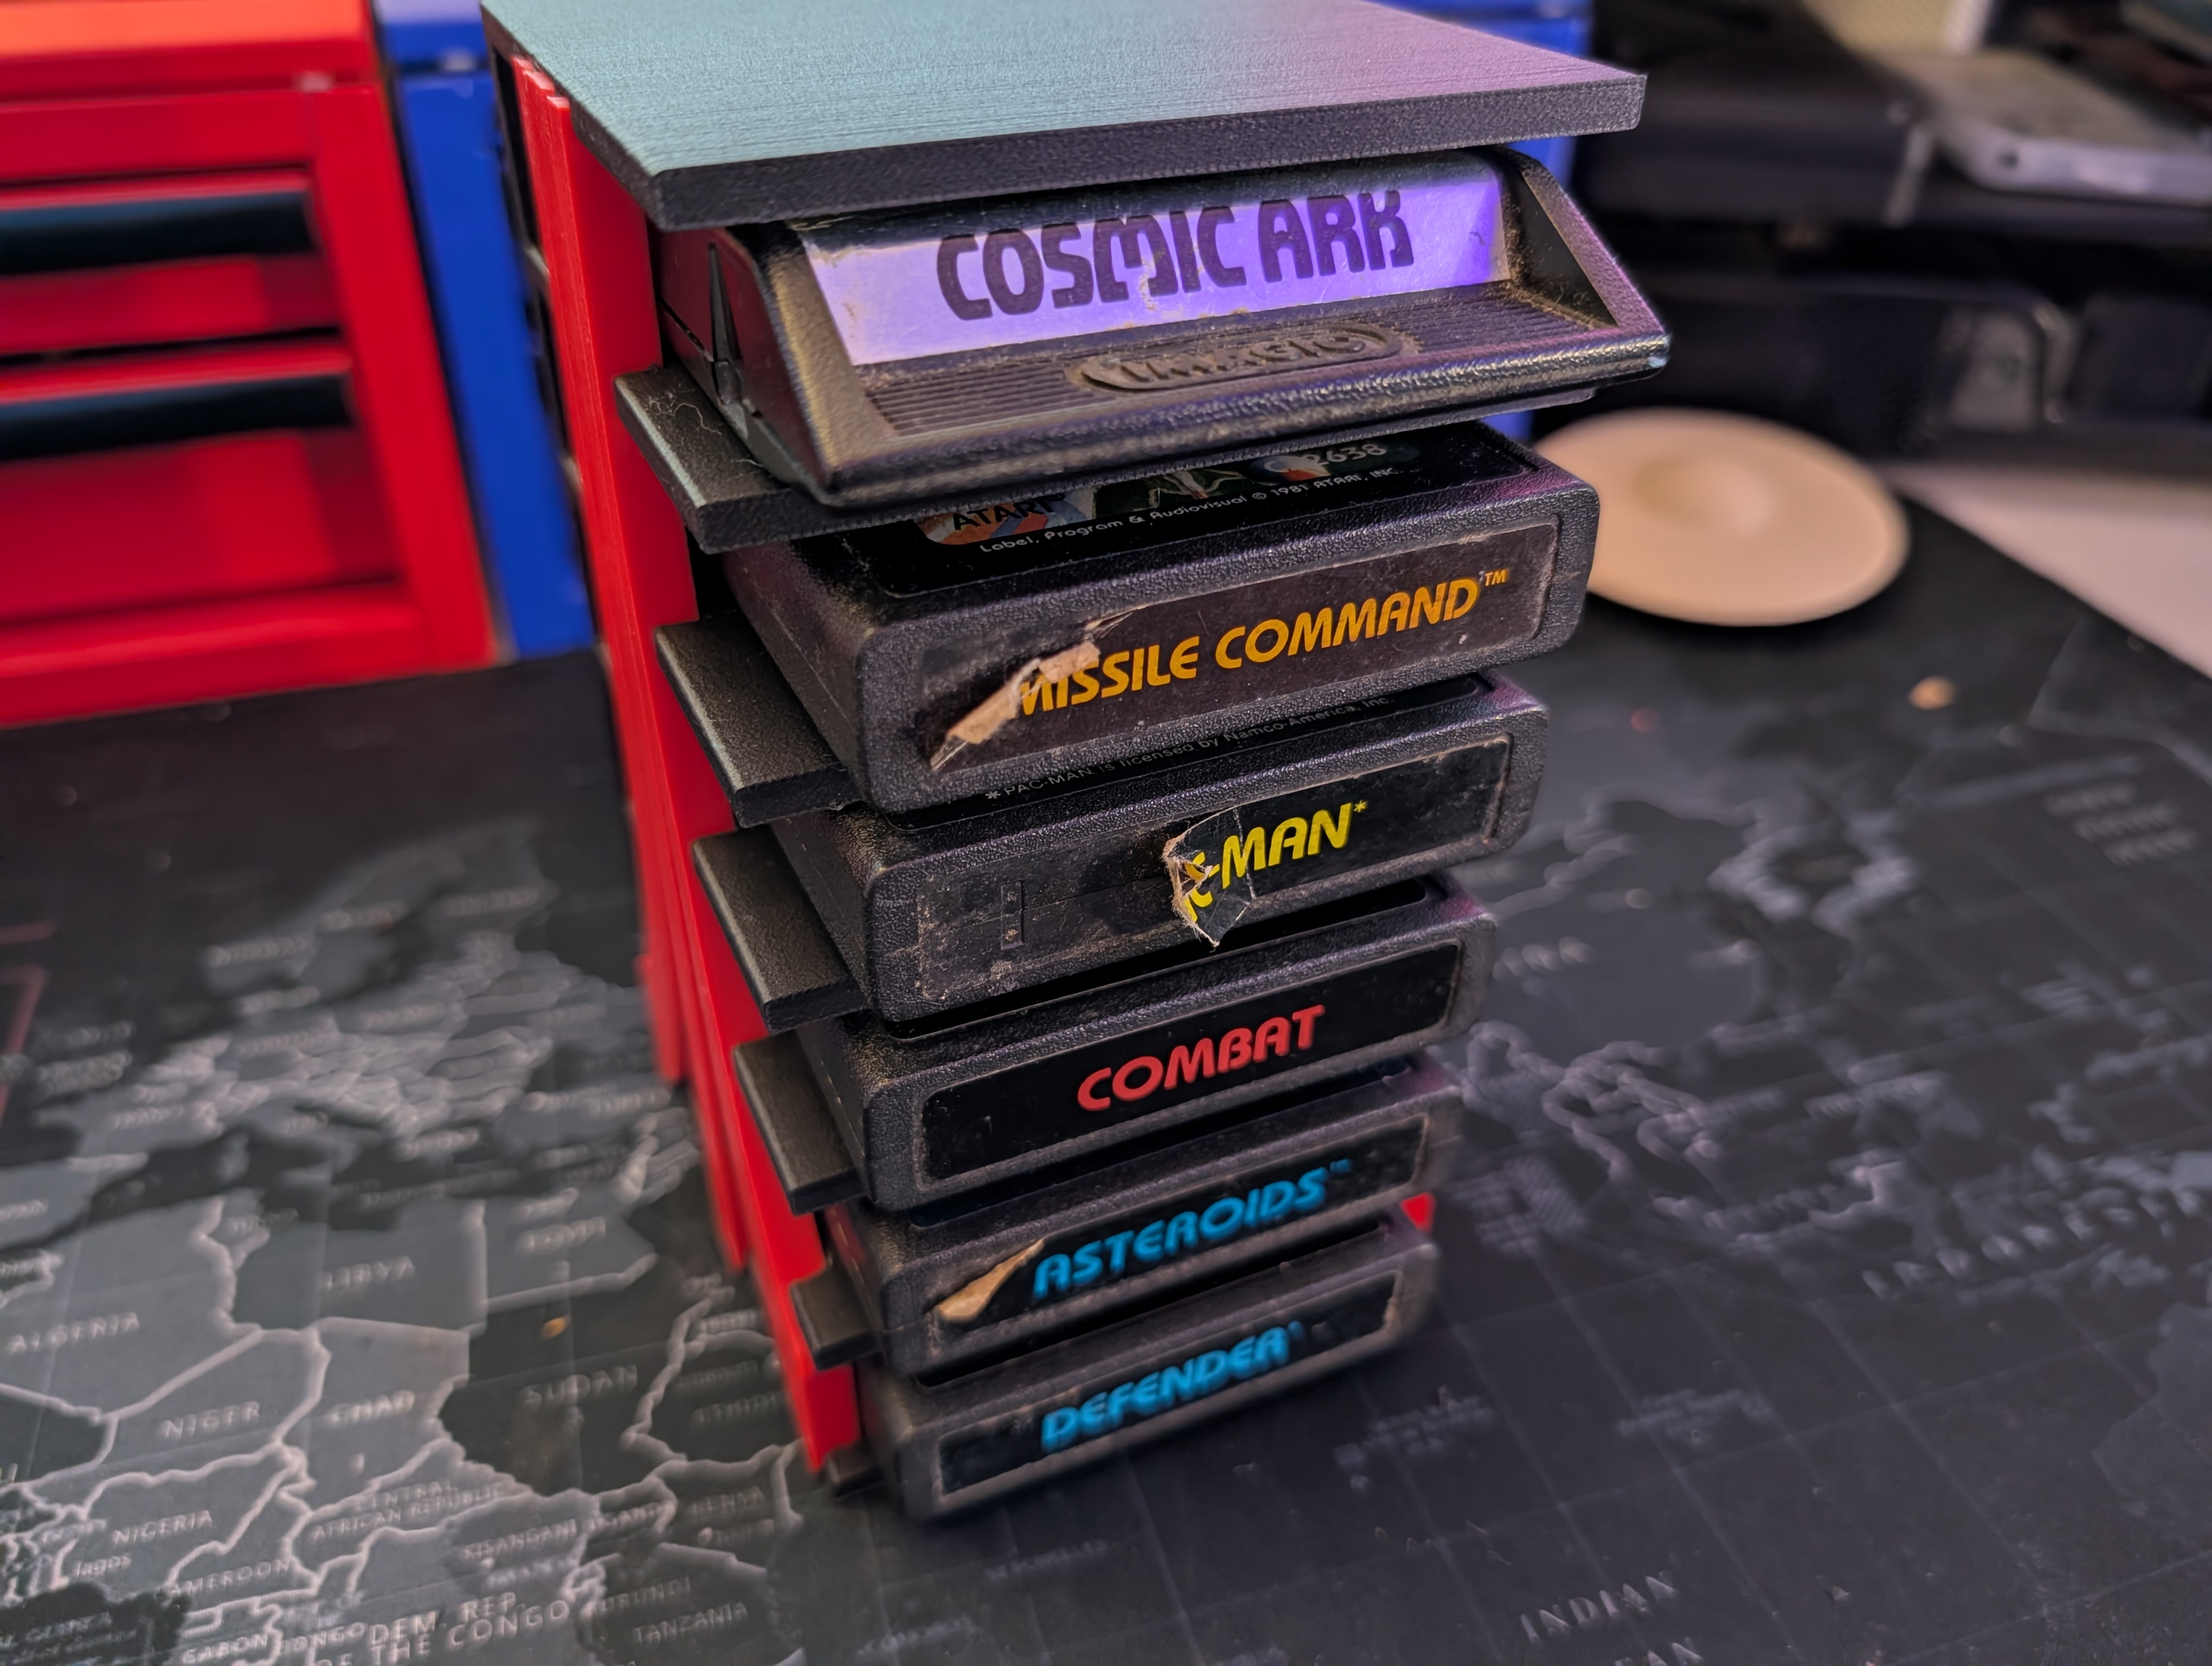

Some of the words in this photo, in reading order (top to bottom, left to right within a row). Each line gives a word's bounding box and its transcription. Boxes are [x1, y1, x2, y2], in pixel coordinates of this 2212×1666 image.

[936, 205, 1248, 321] COSMIC
[1257, 189, 1415, 283] ARK
[979, 536, 1039, 553] Label,
[1044, 520, 1123, 540] Program
[1149, 496, 1248, 520] Audiovisual
[1270, 484, 1307, 497] 1981
[1099, 762, 1115, 773] is
[1120, 744, 1194, 767] licensed
[1198, 738, 1219, 749] by
[1077, 1004, 1326, 1112] COMBAT
[160, 1401, 260, 1438] NIGER
[111, 1510, 213, 1546] NIGERIA
[445, 1600, 570, 1652] CONGO
[632, 1601, 748, 1644] TANZANIA
[182, 1633, 268, 1664] GABON
